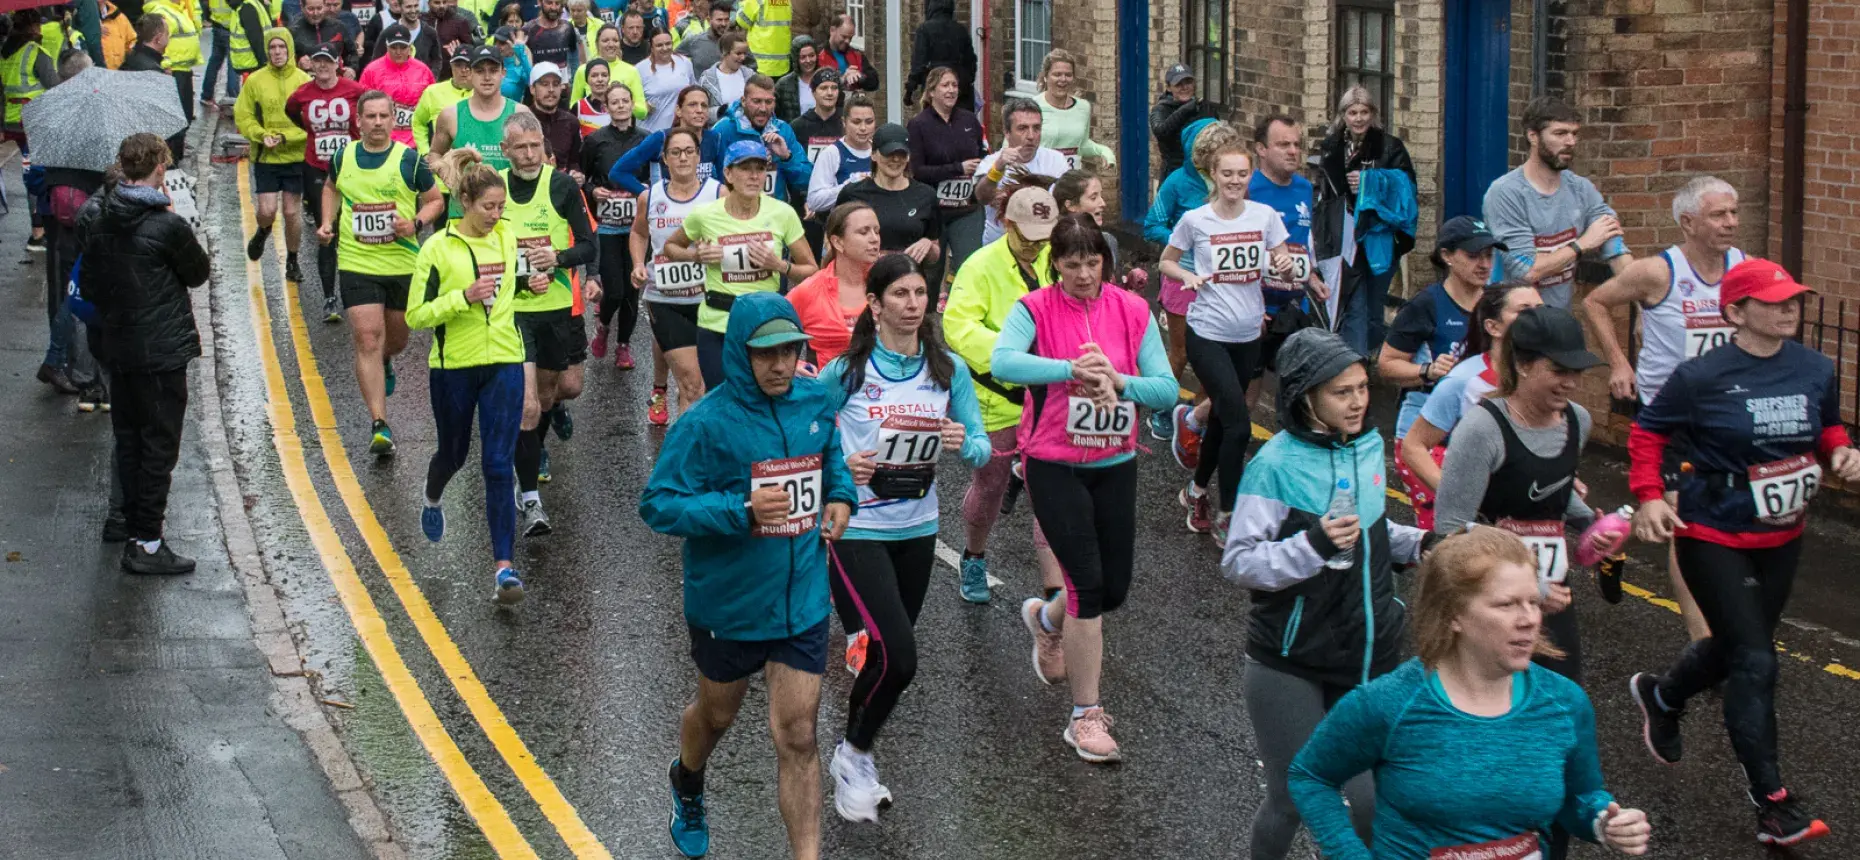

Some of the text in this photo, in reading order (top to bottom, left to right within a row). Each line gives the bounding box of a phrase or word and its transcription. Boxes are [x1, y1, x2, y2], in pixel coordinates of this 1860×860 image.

[308, 98, 350, 123] GO
[392, 111, 413, 126] 84
[319, 137, 347, 153] 448
[941, 182, 971, 199] 440
[601, 200, 633, 219] 250
[1217, 245, 1261, 271] 269
[657, 261, 704, 285] 1003
[1682, 299, 1720, 314] BIRS
[869, 403, 938, 419] BIRSTALL
[1074, 402, 1129, 432] 206
[885, 434, 940, 463] 110
[1073, 433, 1106, 448] Rothley
[1763, 473, 1817, 515] 676
